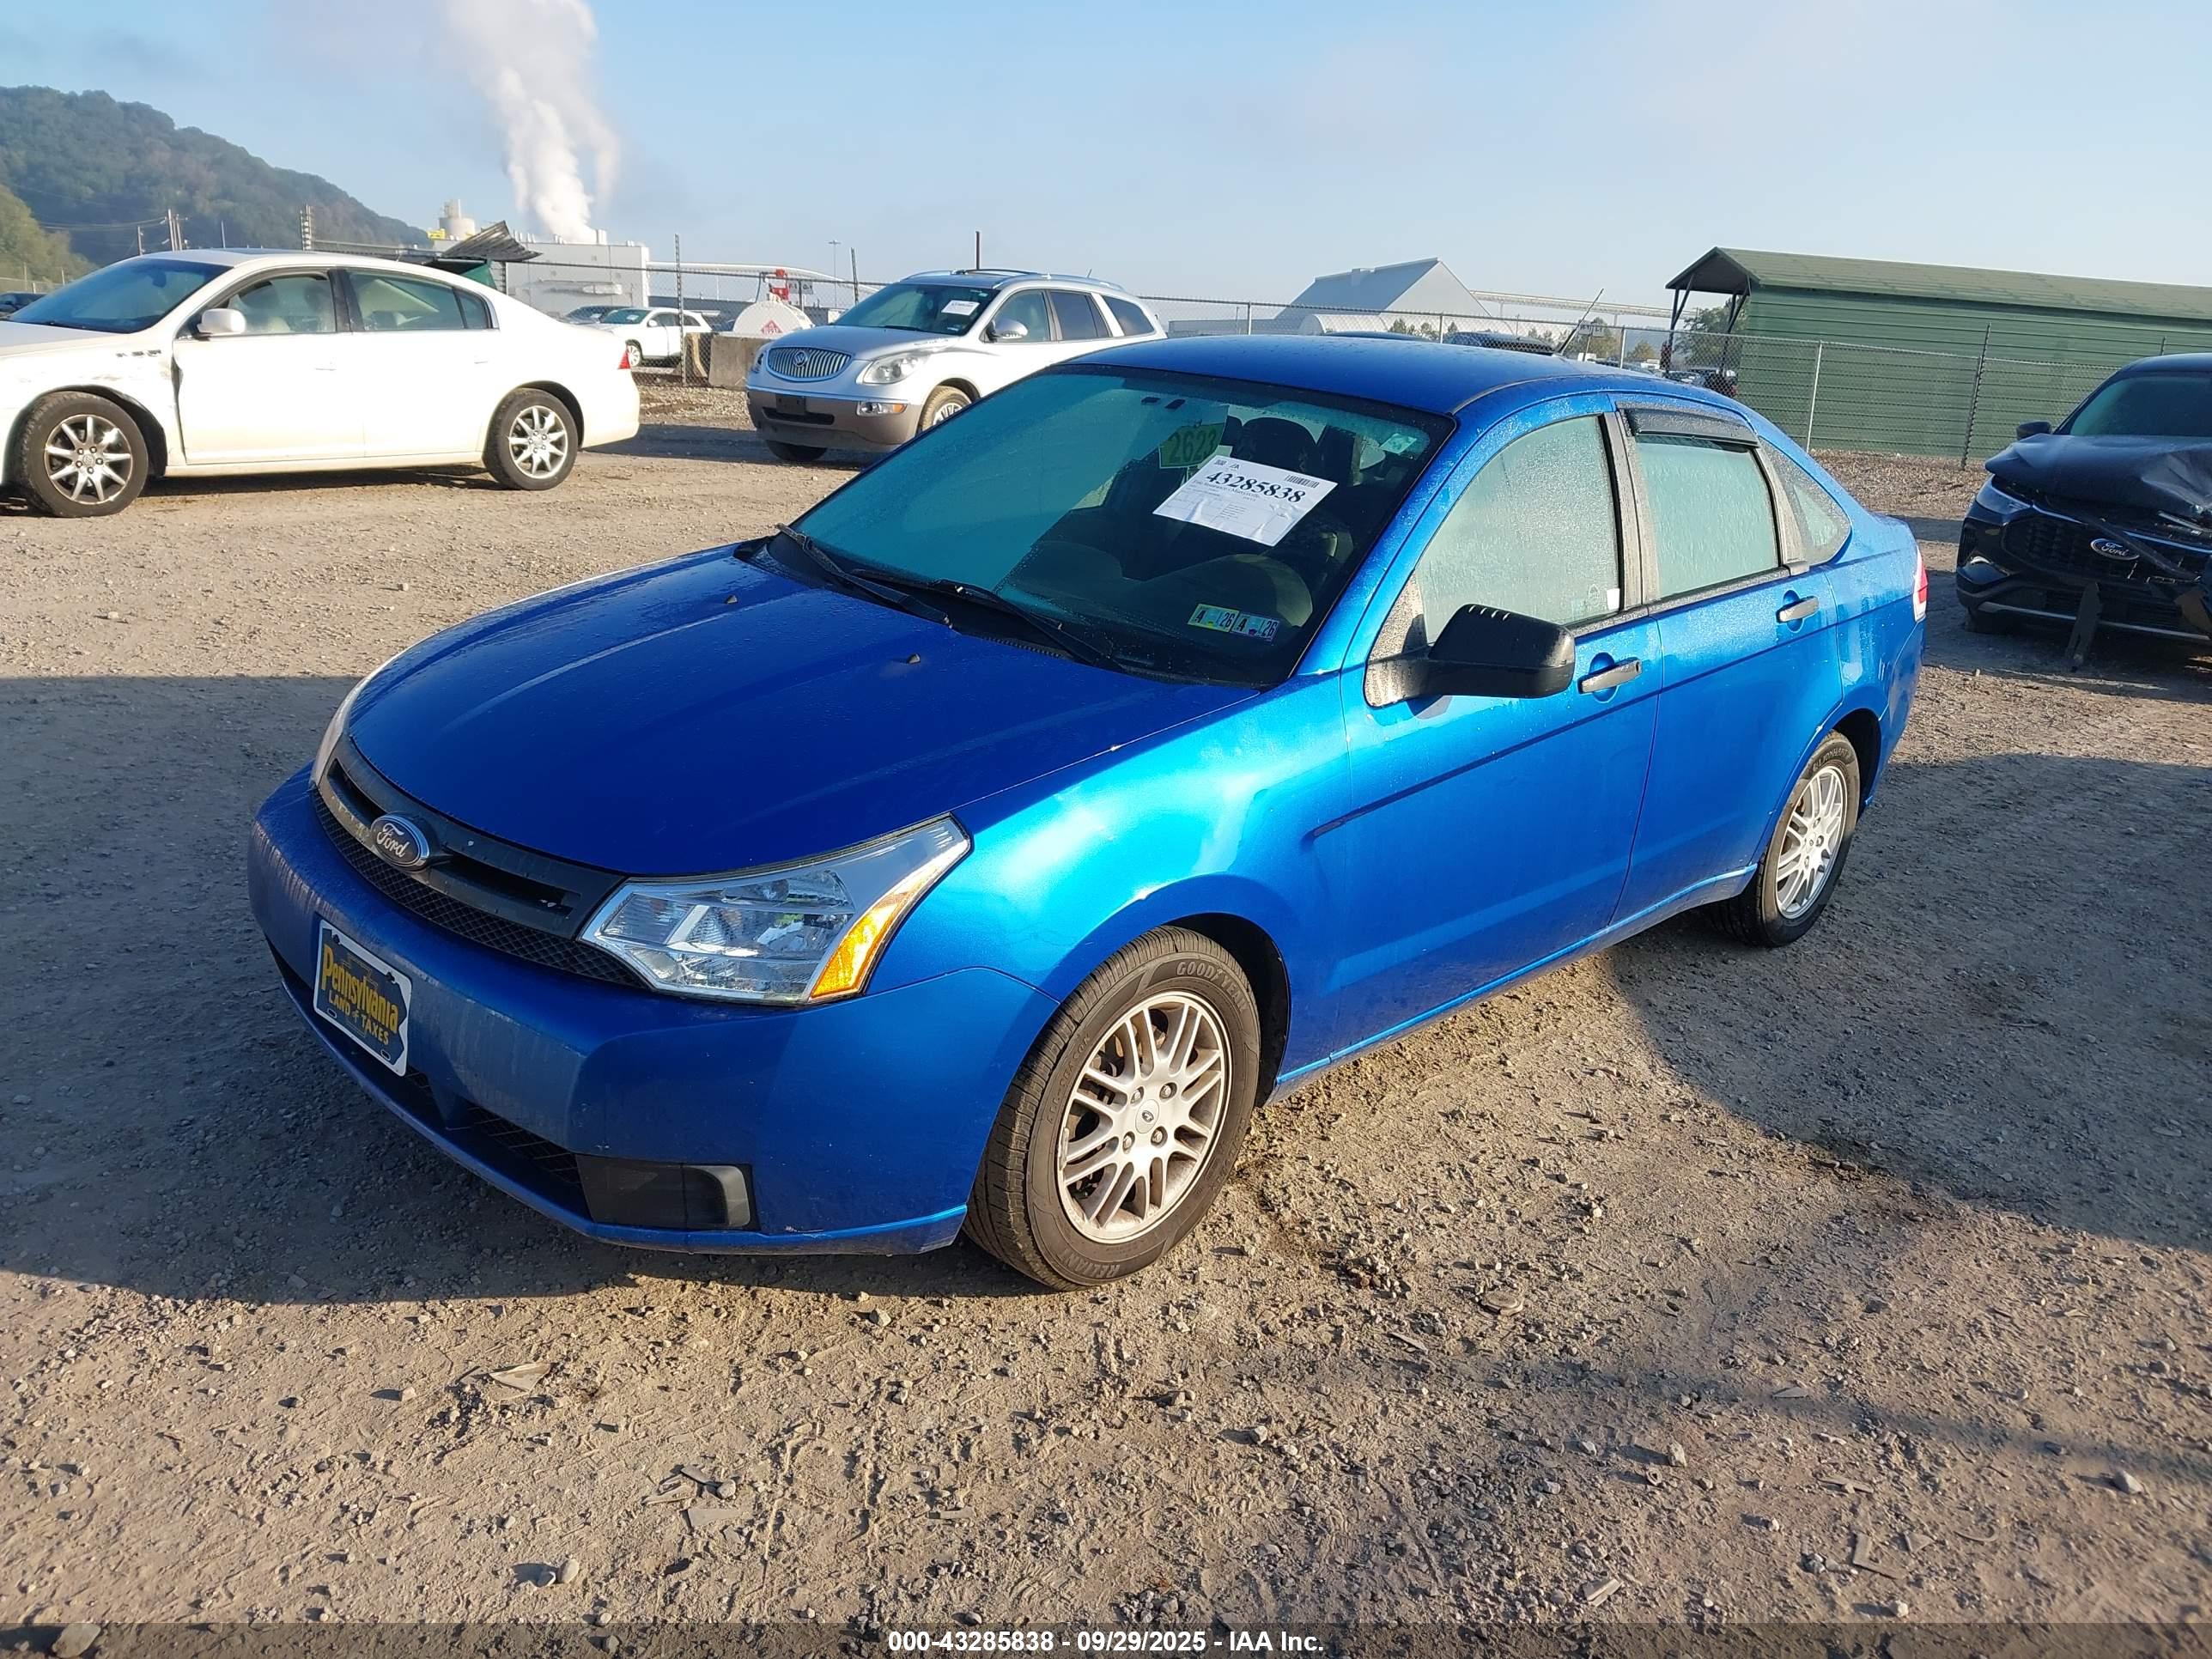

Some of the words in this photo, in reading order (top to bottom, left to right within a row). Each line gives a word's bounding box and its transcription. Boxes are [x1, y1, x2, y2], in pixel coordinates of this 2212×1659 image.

[1206, 471, 1306, 503] 43285838
[2101, 542, 2130, 556] Ford
[1194, 610, 1206, 623] 4
[1219, 612, 1236, 628] 26
[1237, 618, 1248, 632] 4
[376, 823, 410, 858] Ford
[321, 944, 398, 1034] Pennsylvania
[328, 990, 351, 1016] LAND
[361, 1014, 389, 1046] TAXES
